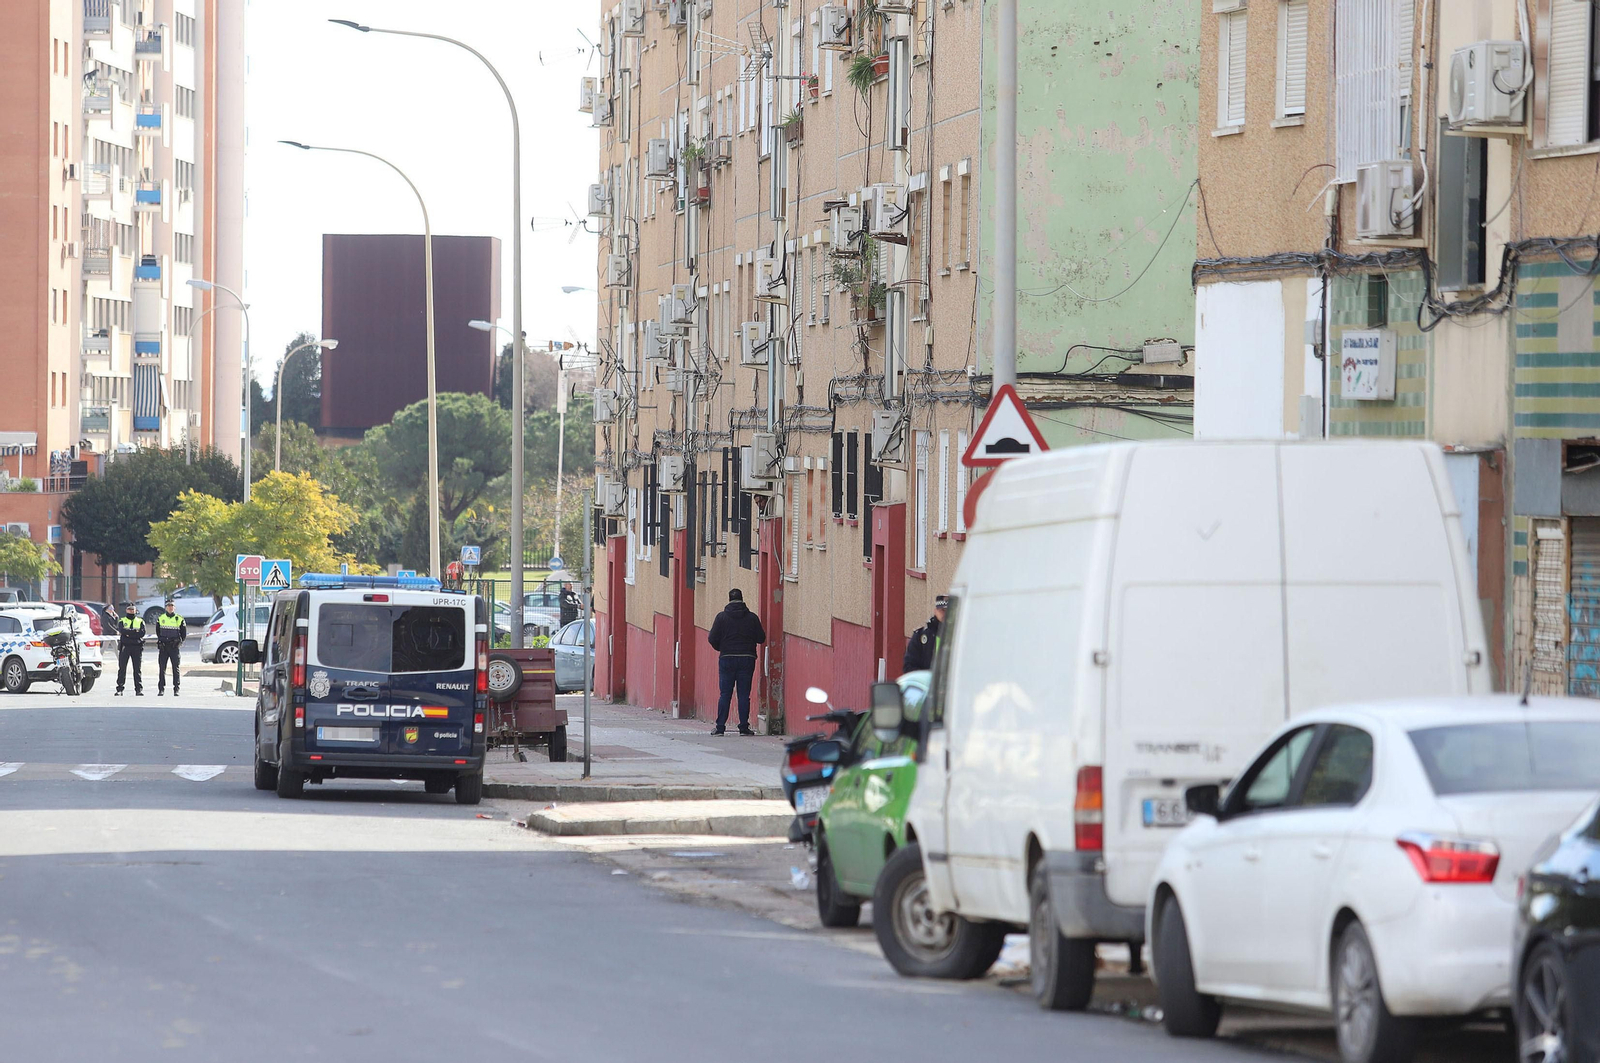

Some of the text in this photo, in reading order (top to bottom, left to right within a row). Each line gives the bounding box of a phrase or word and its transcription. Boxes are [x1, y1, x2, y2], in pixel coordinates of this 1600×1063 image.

[240, 567, 260, 575] STO
[433, 598, 466, 606] UPR-17C
[345, 680, 379, 688] TRAFIC
[336, 704, 425, 718] POLICIA
